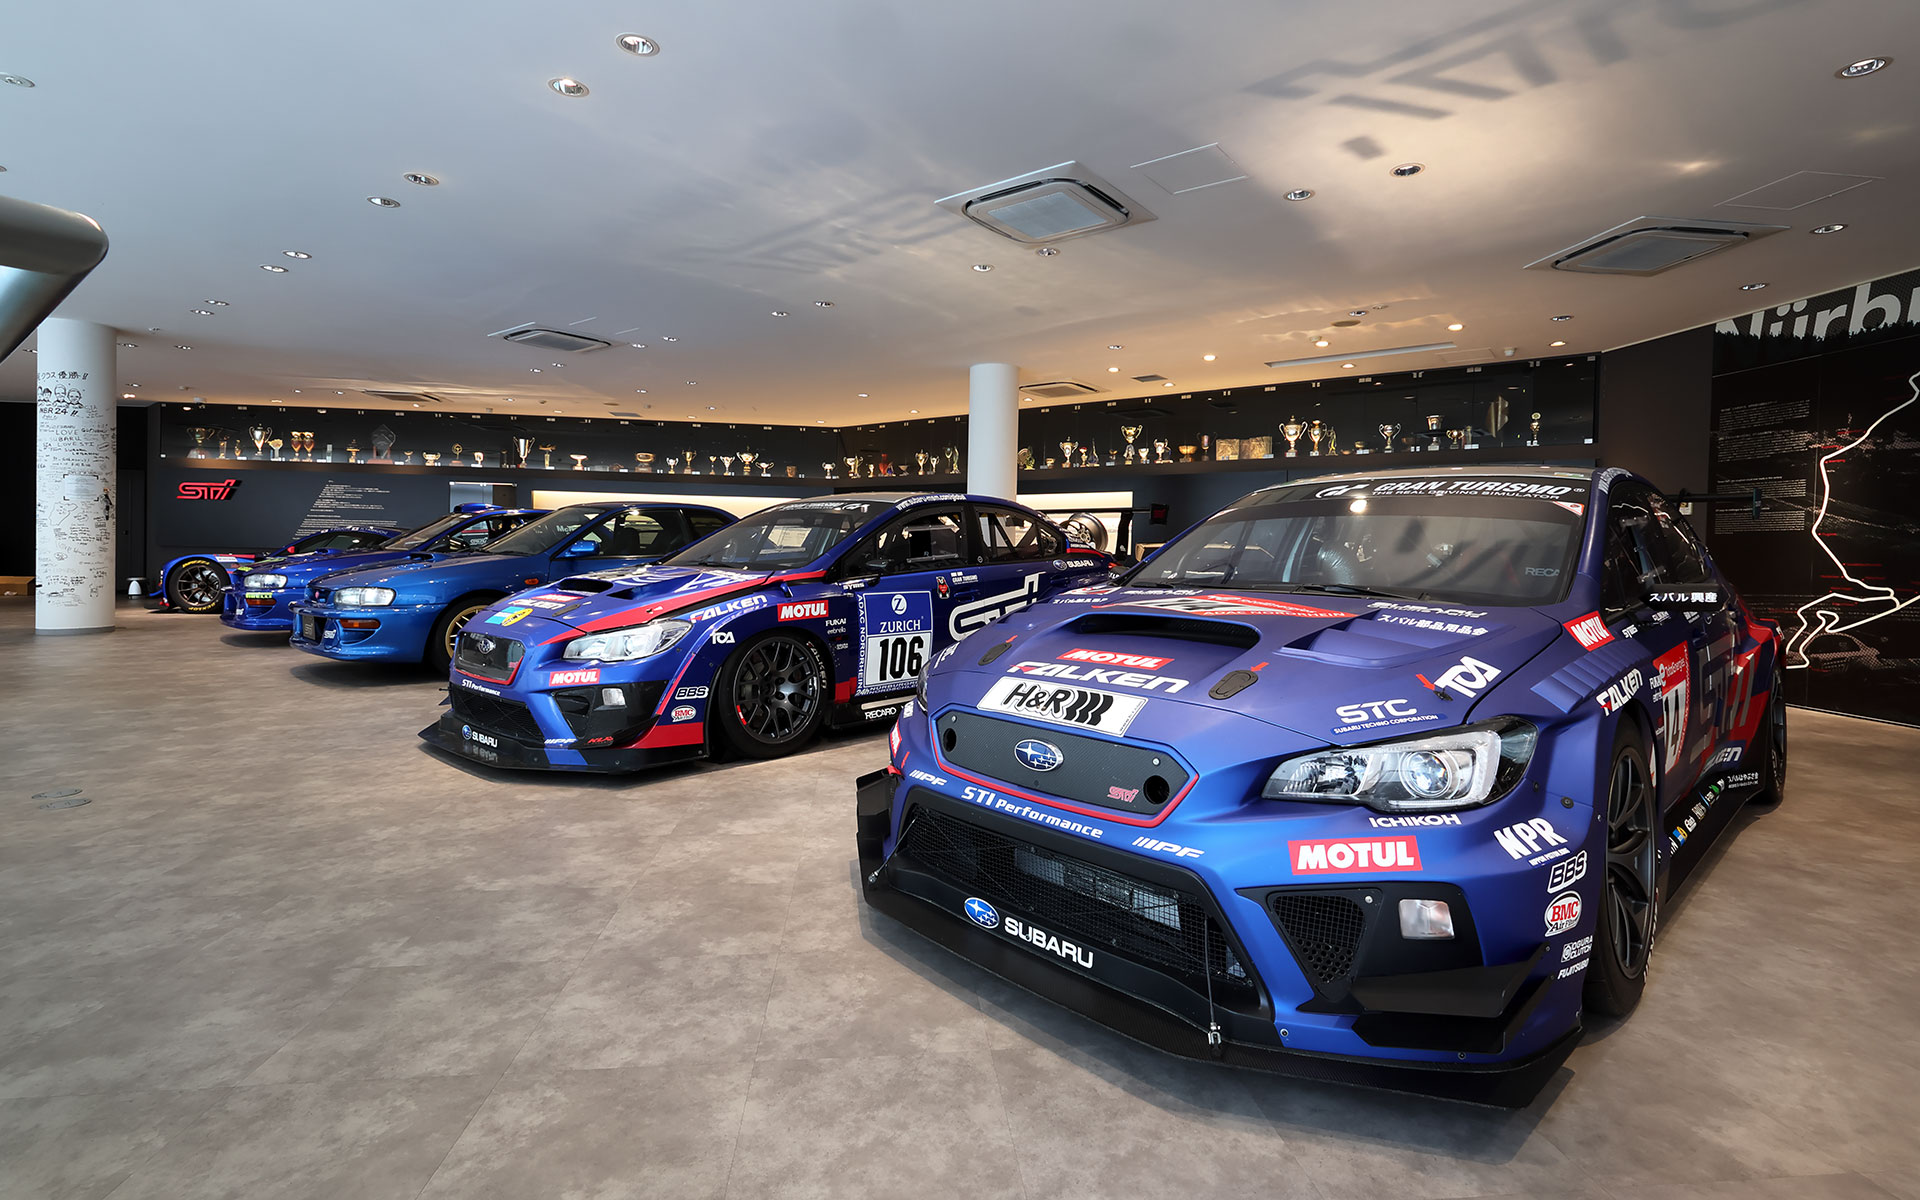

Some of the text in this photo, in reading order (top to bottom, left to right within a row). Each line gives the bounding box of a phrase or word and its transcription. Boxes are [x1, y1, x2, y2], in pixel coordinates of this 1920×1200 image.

[1374, 481, 1446, 492] GRAN
[1447, 480, 1577, 496] TURISMO
[1467, 491, 1560, 500] SIMULATOR
[1066, 560, 1094, 568] SUBARU
[1649, 592, 1718, 603] スバル興産
[688, 594, 768, 623] FALKEN
[780, 602, 827, 620] MOTUL
[825, 618, 847, 627] FUKAI
[880, 620, 921, 633] ZURICH
[710, 631, 736, 645] TOA
[857, 594, 865, 689] ADAC NORDRHEIN
[1570, 617, 1611, 648] MOTUL
[879, 636, 925, 681] 106
[1066, 650, 1163, 668] MOTUL
[551, 671, 598, 685] MOTUL
[1007, 661, 1190, 694] FALKEN
[462, 679, 501, 697] STI Performance
[676, 687, 708, 699] BBS
[1596, 669, 1644, 716] FALKEN
[1002, 683, 1073, 714] H&R
[674, 709, 695, 717] BMC
[864, 707, 897, 720] RECARO
[1336, 699, 1417, 724] STC
[1333, 714, 1439, 734] SUBARU TECHNO CORPORATION
[472, 731, 498, 748] SUBARU
[961, 786, 1104, 839] STI Performance
[1368, 813, 1463, 828] ICHIKOH
[1493, 817, 1569, 861] NPR
[1296, 840, 1415, 870] MOTUL
[1548, 851, 1587, 892] BBS
[1550, 901, 1579, 922] BMC
[1003, 916, 1094, 969] SUBARU
[1571, 935, 1593, 950] OGURA
[1557, 958, 1590, 979] FUJITSUBO
